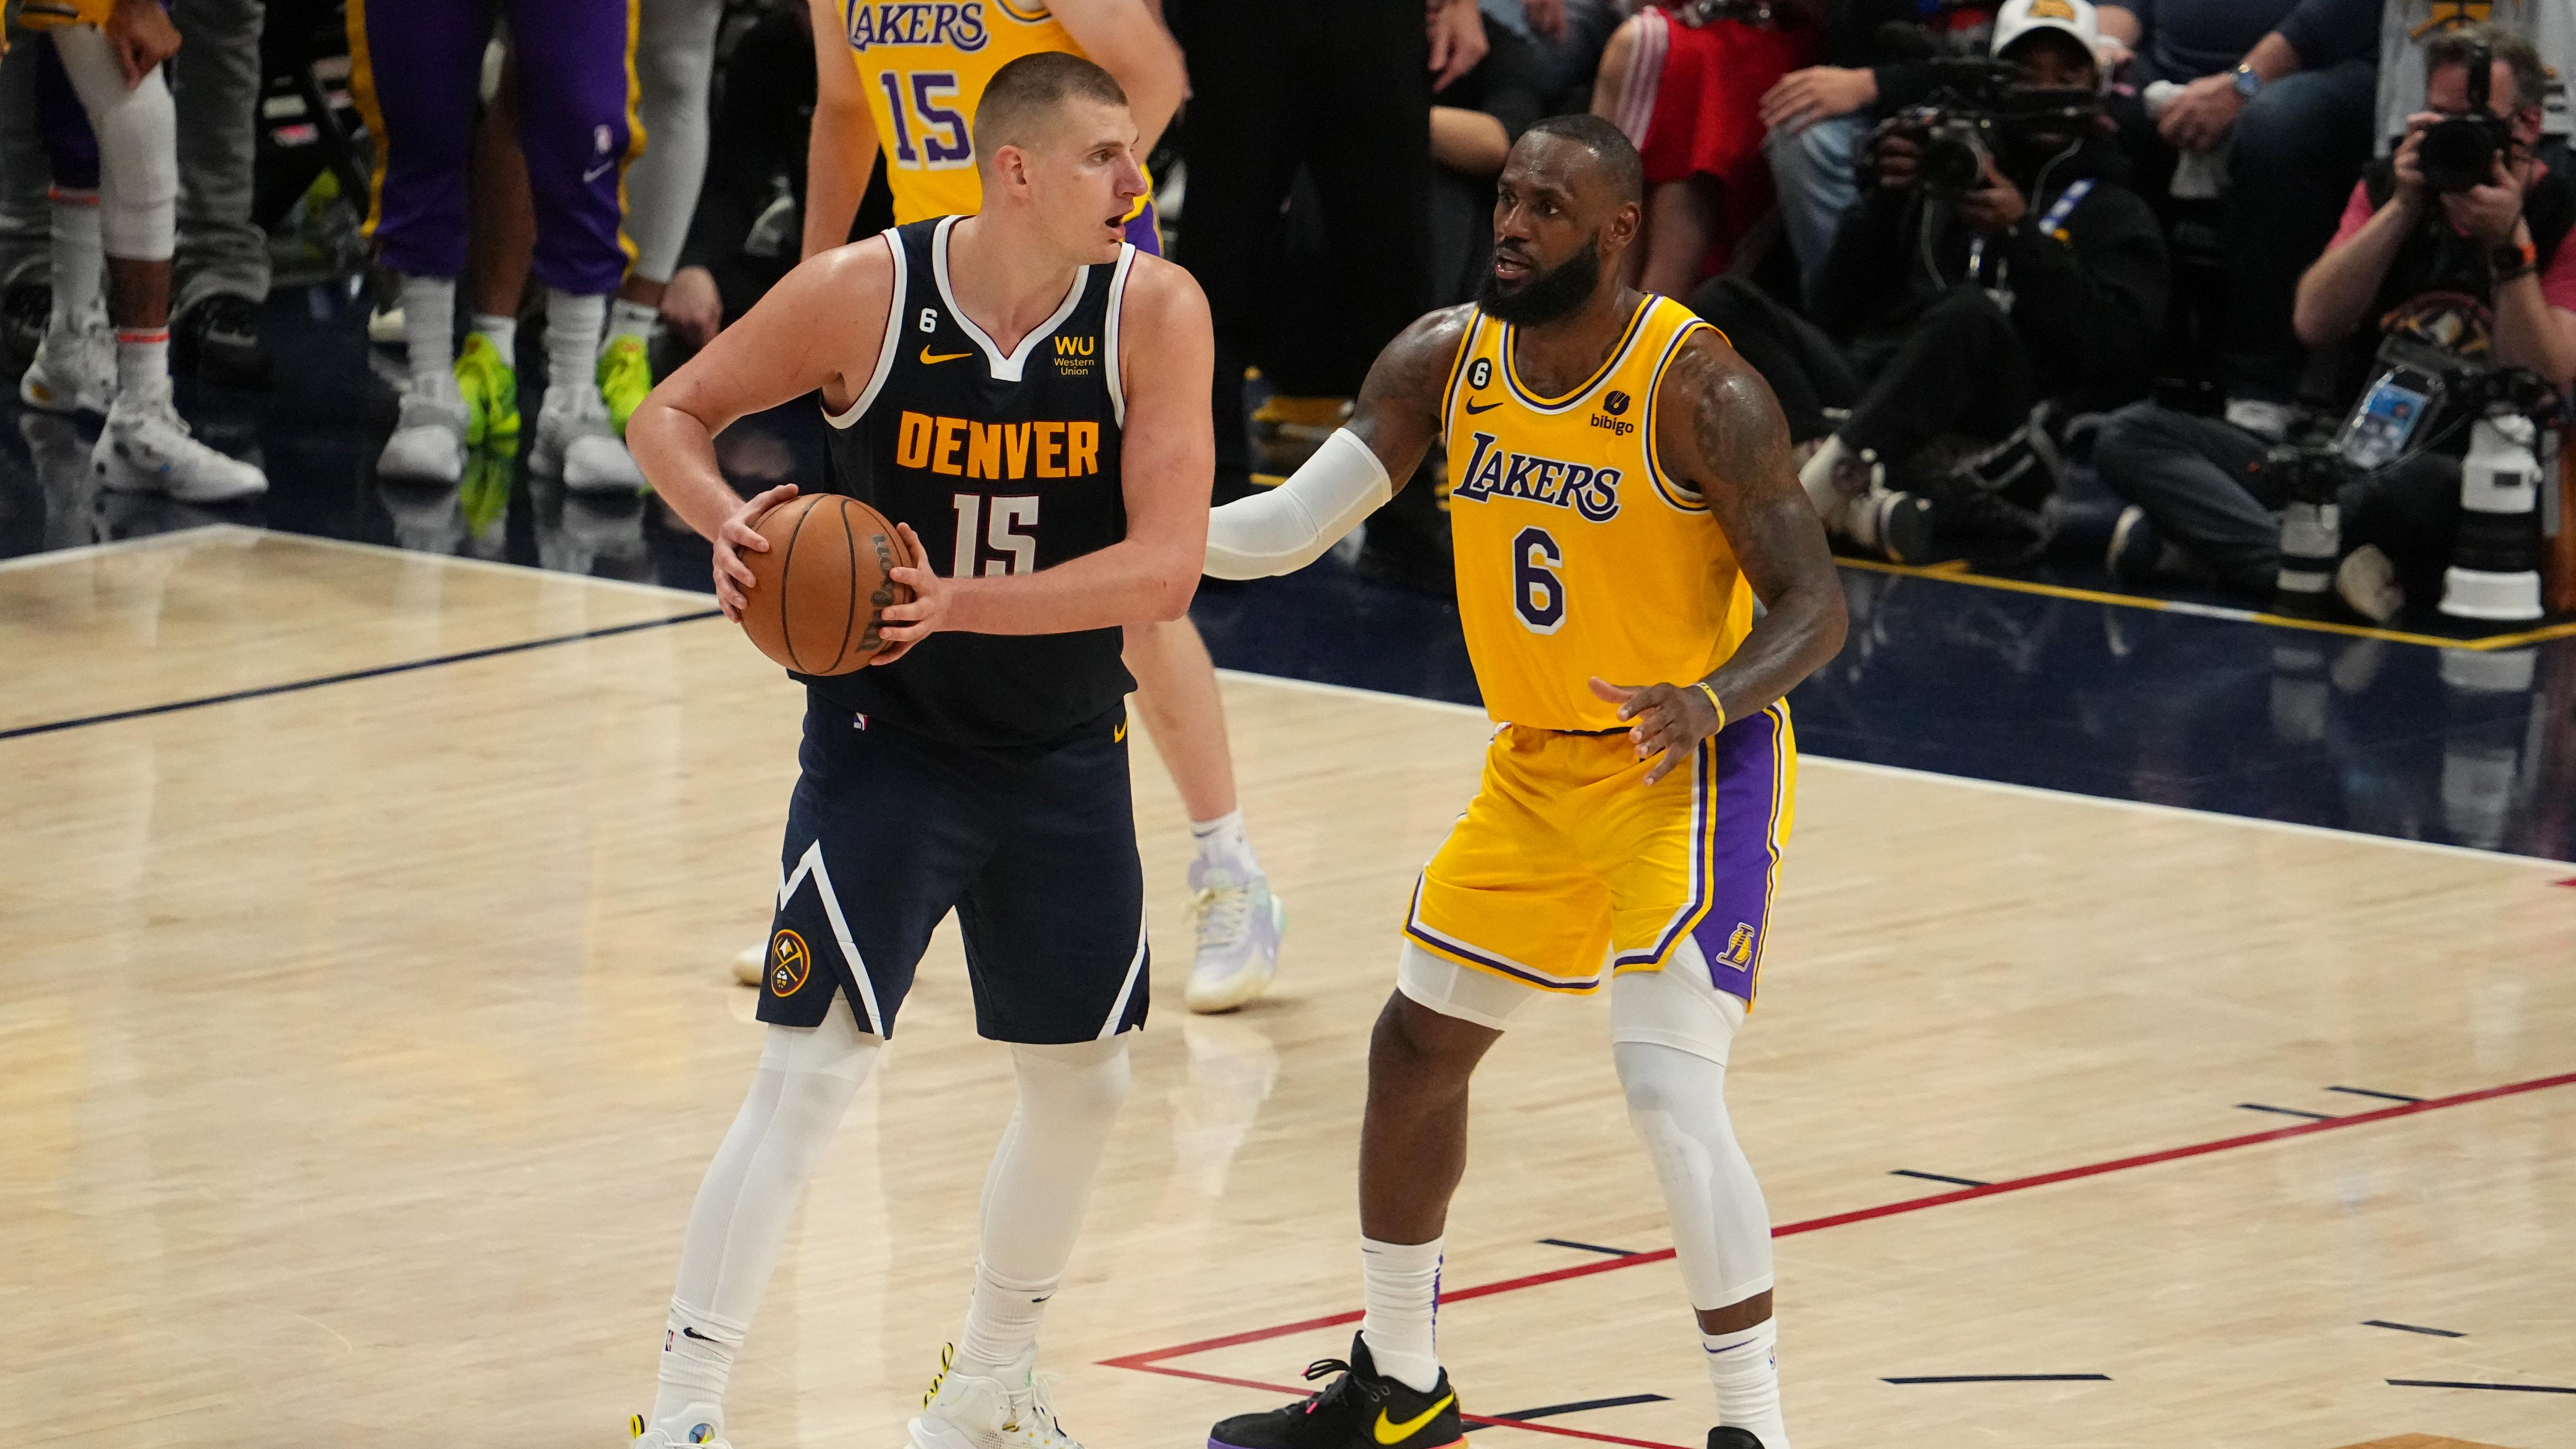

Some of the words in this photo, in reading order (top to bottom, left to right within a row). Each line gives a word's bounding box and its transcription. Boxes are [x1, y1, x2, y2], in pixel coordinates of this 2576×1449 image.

[846, 0, 989, 52] LAKERS
[880, 71, 974, 168] 15
[920, 308, 937, 333] 6
[1055, 336, 1094, 355] WU
[1473, 362, 1489, 386] 6
[896, 411, 1099, 479] DENVER
[1591, 413, 1634, 436] bibigo
[1453, 432, 1622, 522] LAKERS
[953, 493, 1039, 578] 15
[1512, 526, 1565, 634] 6
